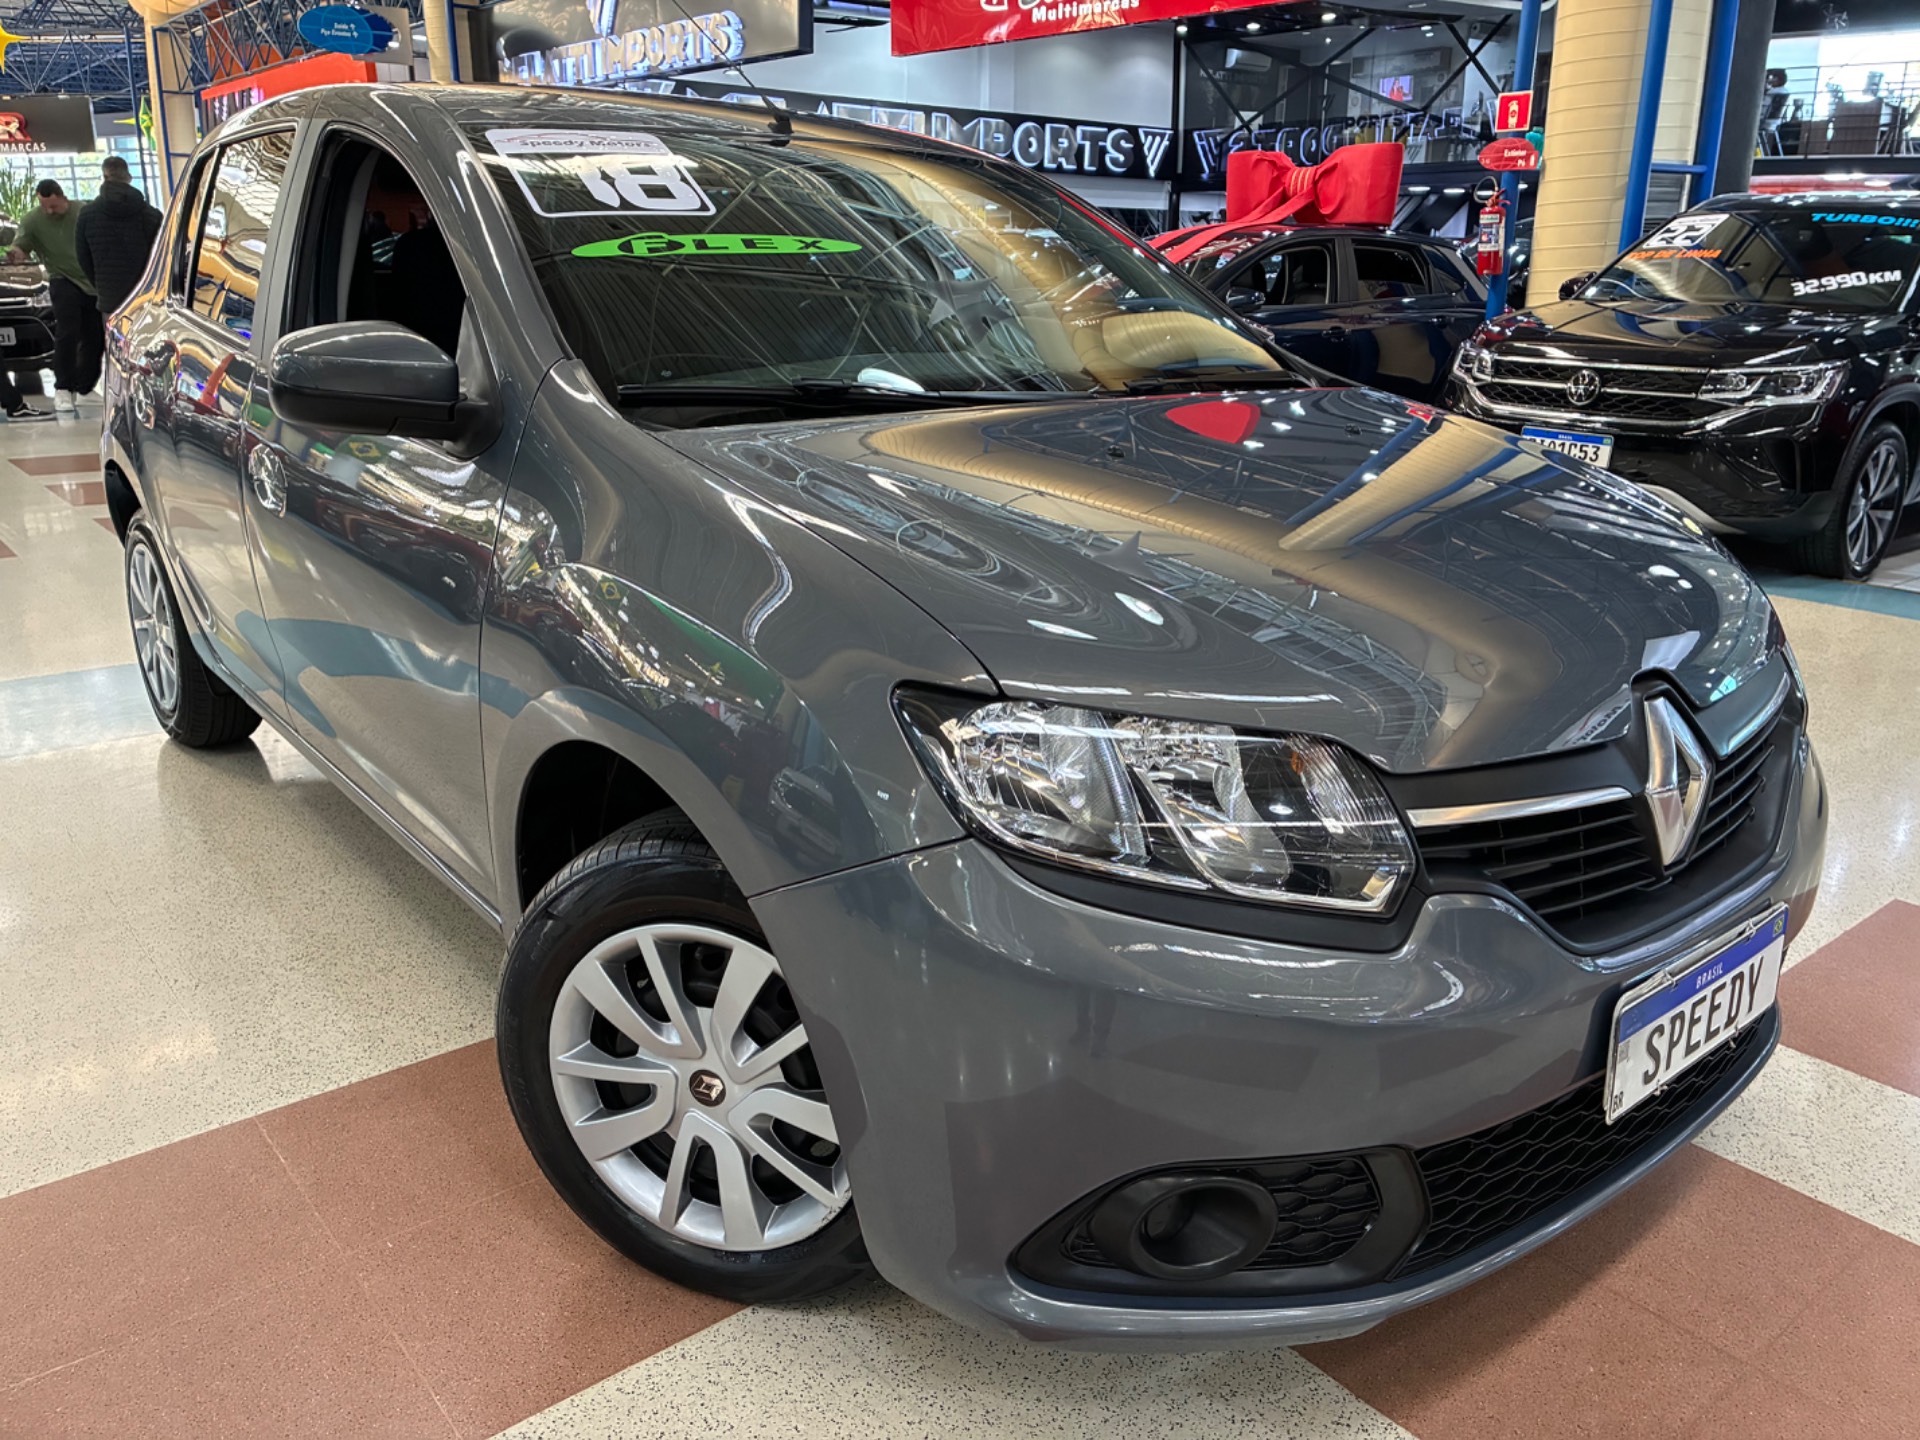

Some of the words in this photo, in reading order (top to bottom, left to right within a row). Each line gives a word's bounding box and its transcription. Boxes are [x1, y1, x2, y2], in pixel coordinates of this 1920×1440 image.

[1032, 0, 1139, 23] Multimarcas
[596, 10, 744, 78] IMPORTS
[520, 139, 584, 148] Speedy
[589, 140, 652, 148] Motors
[571, 155, 701, 209] 18
[627, 234, 831, 255] FLEX
[1656, 225, 1713, 247] 22
[1696, 961, 1723, 990] BRASIL
[1643, 955, 1764, 1086] SPEEDY
